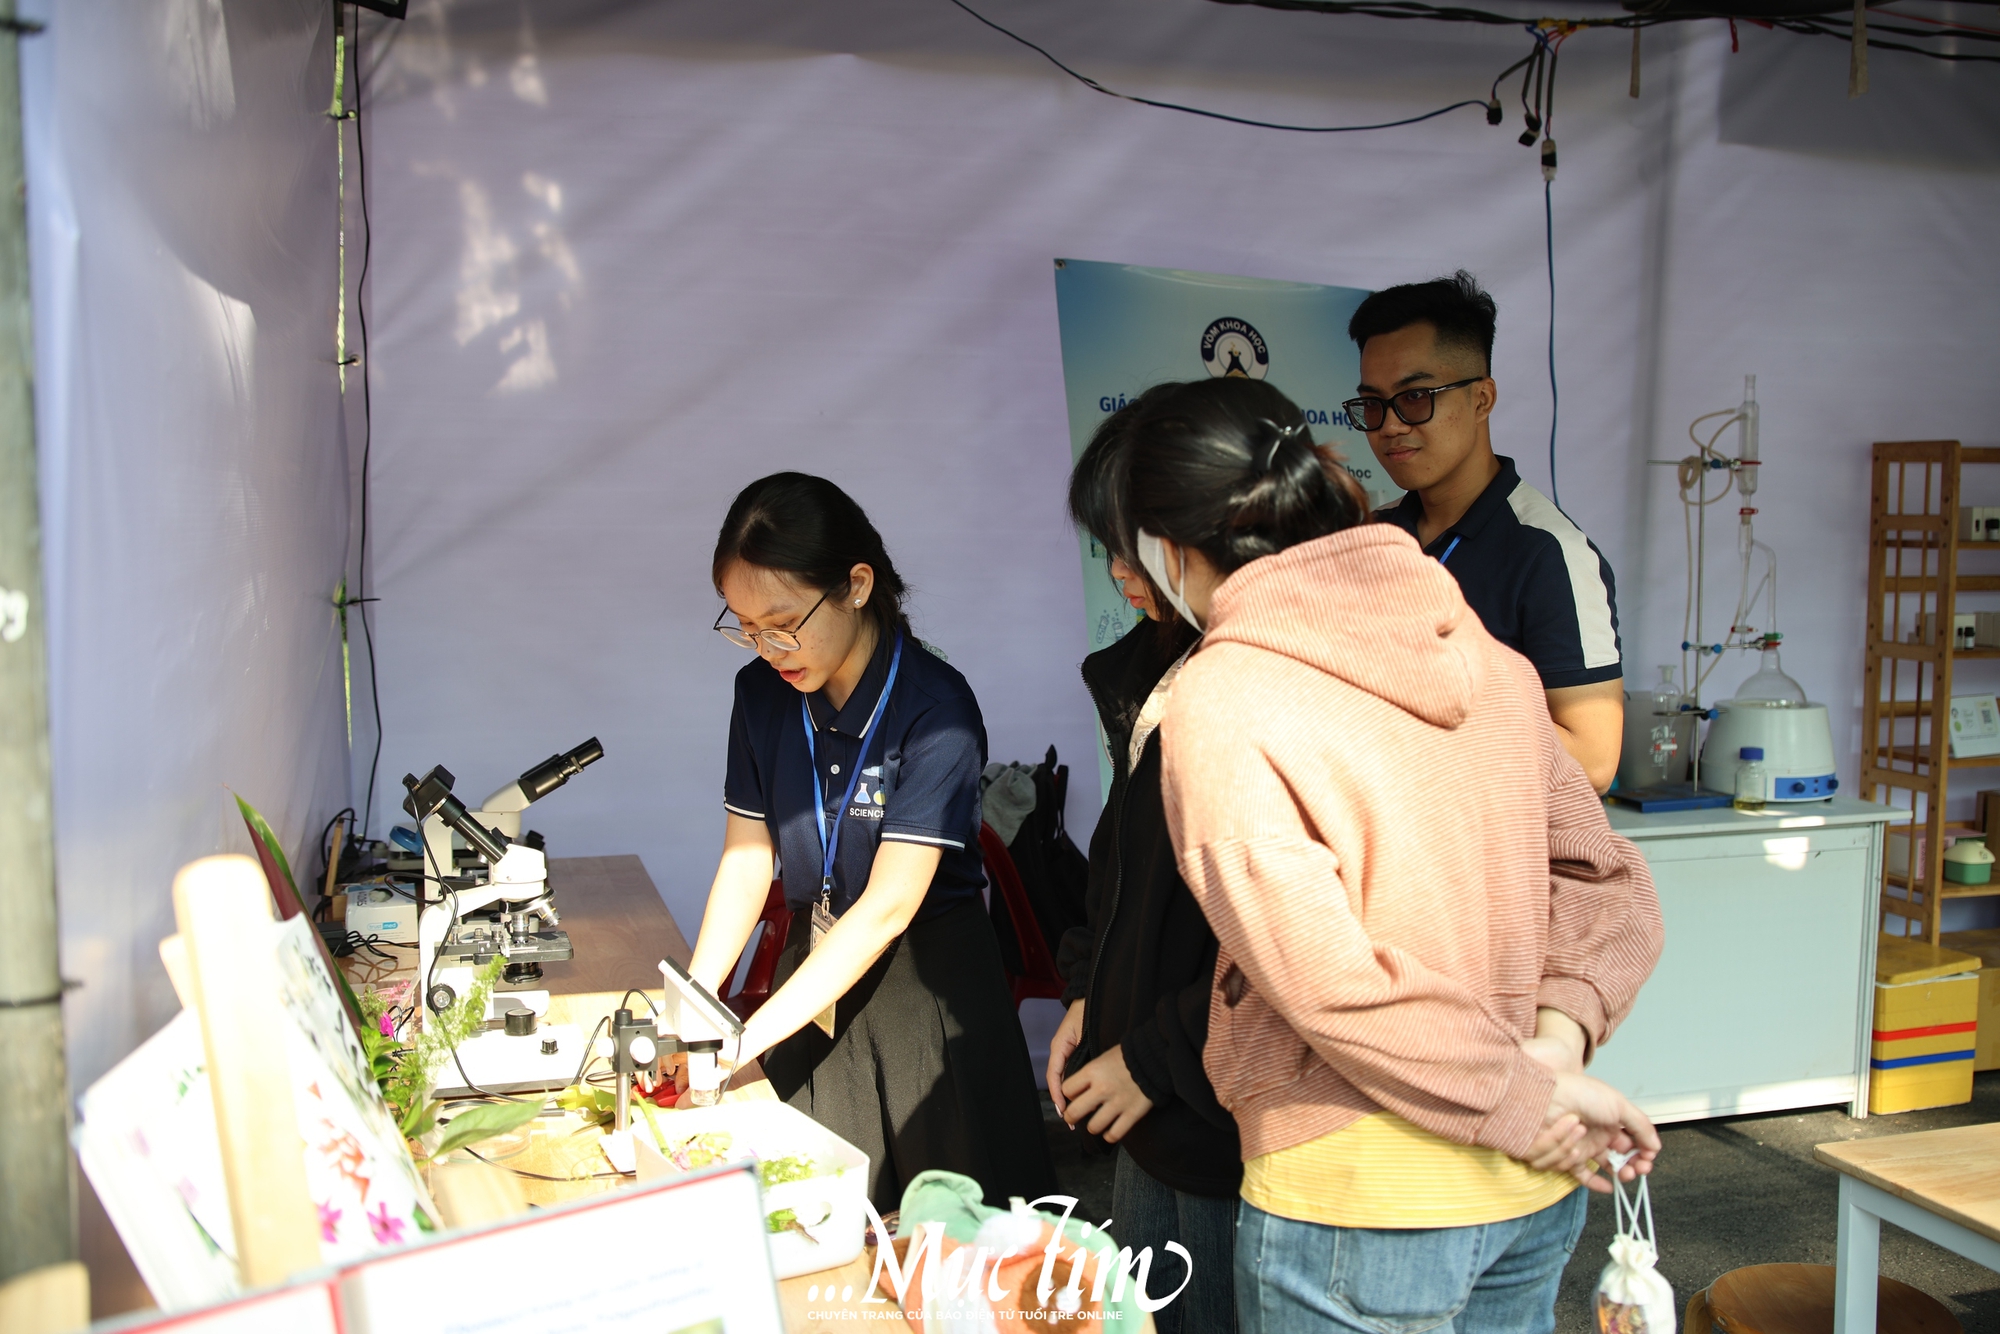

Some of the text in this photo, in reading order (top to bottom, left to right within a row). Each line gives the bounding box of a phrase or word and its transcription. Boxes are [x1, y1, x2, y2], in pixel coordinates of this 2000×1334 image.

[1219, 320, 1247, 334] KHOA
[1248, 330, 1266, 354] HỌC
[1099, 393, 1138, 412] GIÁ
